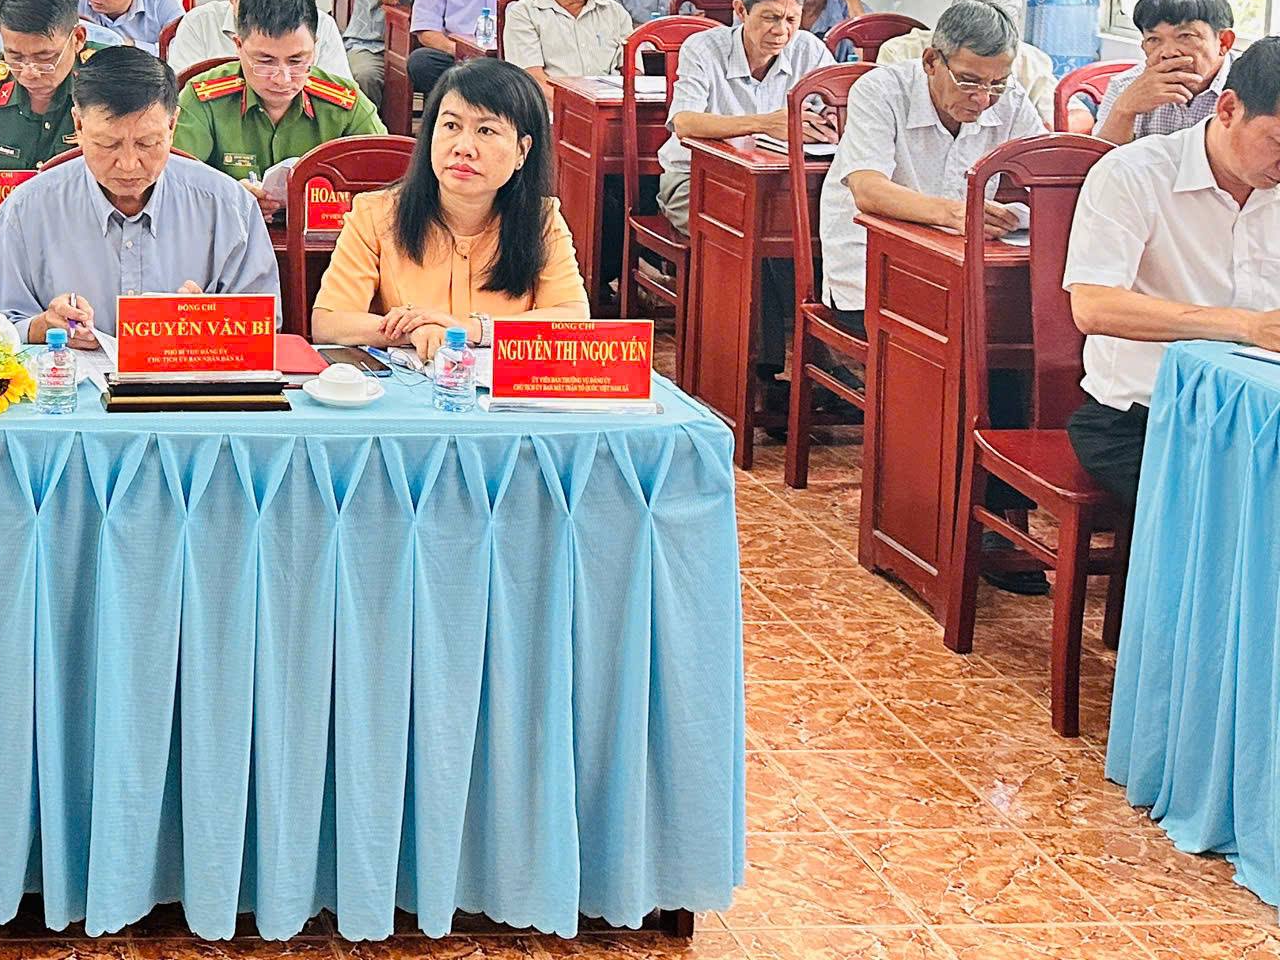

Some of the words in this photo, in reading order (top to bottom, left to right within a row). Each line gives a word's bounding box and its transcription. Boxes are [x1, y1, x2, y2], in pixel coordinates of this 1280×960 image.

[122, 317, 202, 337] NGUYỄN
[207, 317, 246, 336] VĂN
[498, 334, 552, 360] NGUYỄN
[556, 340, 578, 367] THỊ
[580, 340, 620, 367] NGỌC
[621, 335, 648, 362] YẾN
